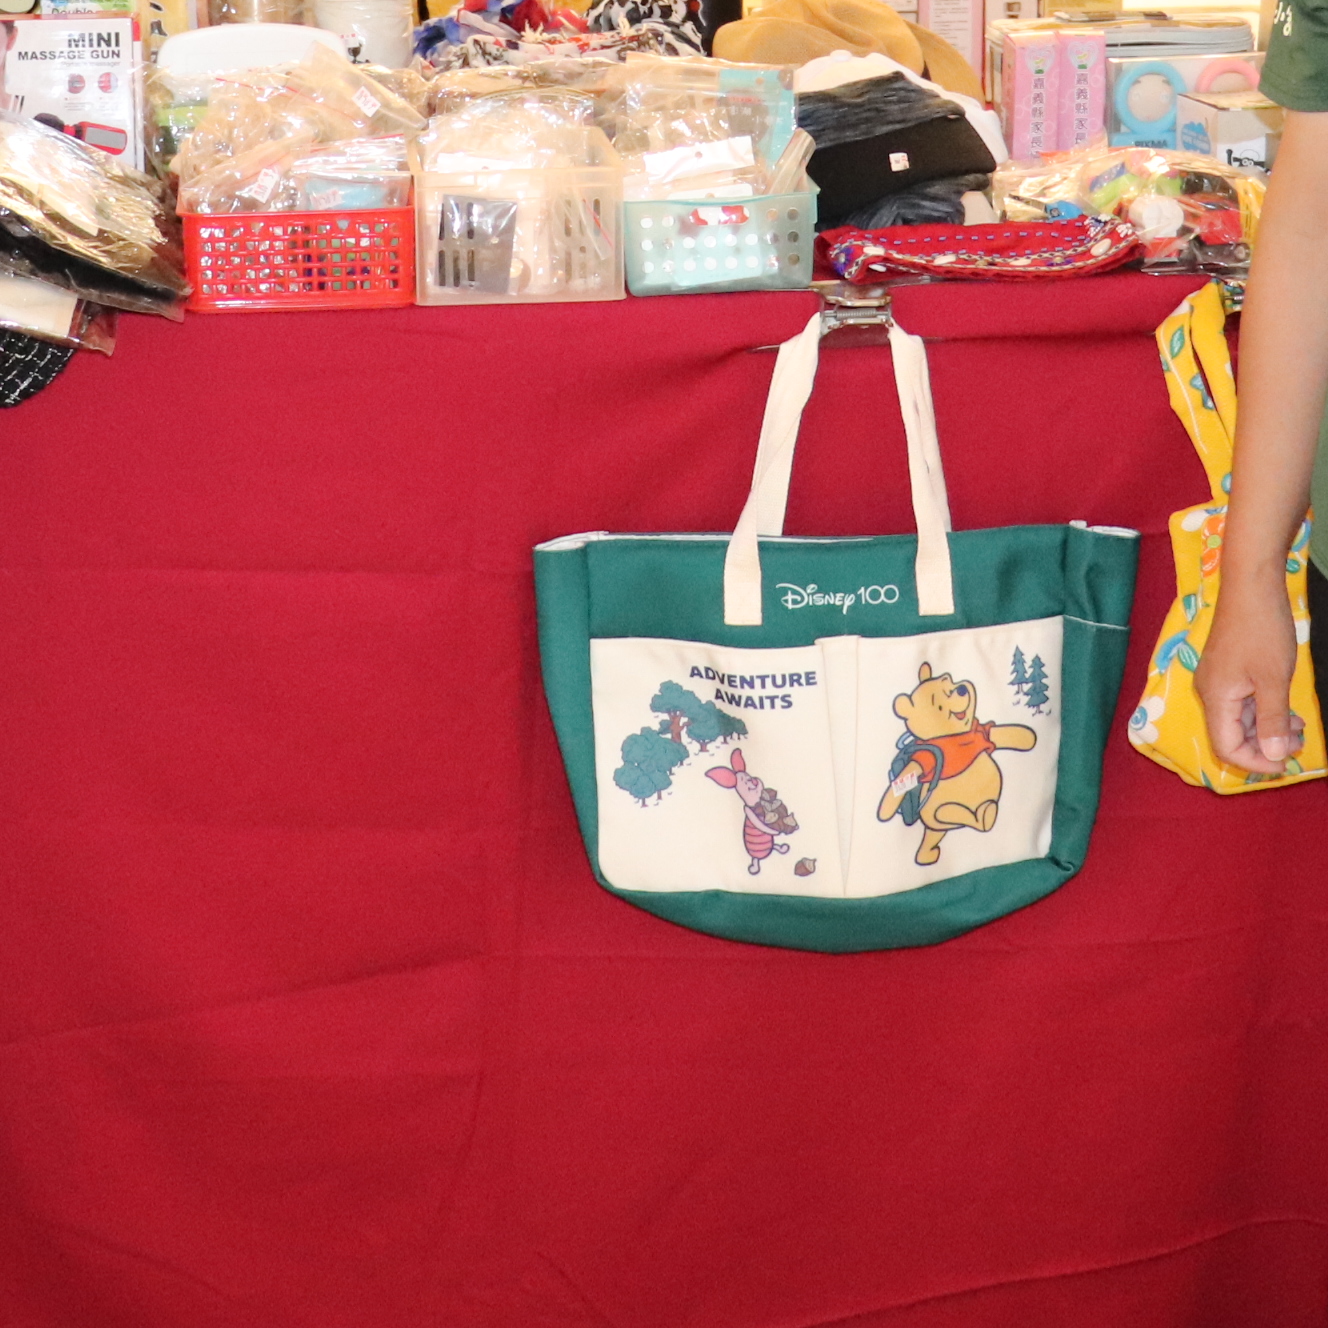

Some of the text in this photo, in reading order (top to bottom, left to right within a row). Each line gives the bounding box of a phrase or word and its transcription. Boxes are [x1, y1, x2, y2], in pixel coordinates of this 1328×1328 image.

[68, 32, 120, 49] MINI
[18, 49, 121, 61] MASSAGE GUN
[775, 582, 899, 614] Disney 100
[689, 664, 818, 690] ADVENTURE
[713, 687, 793, 710] AWAITS
